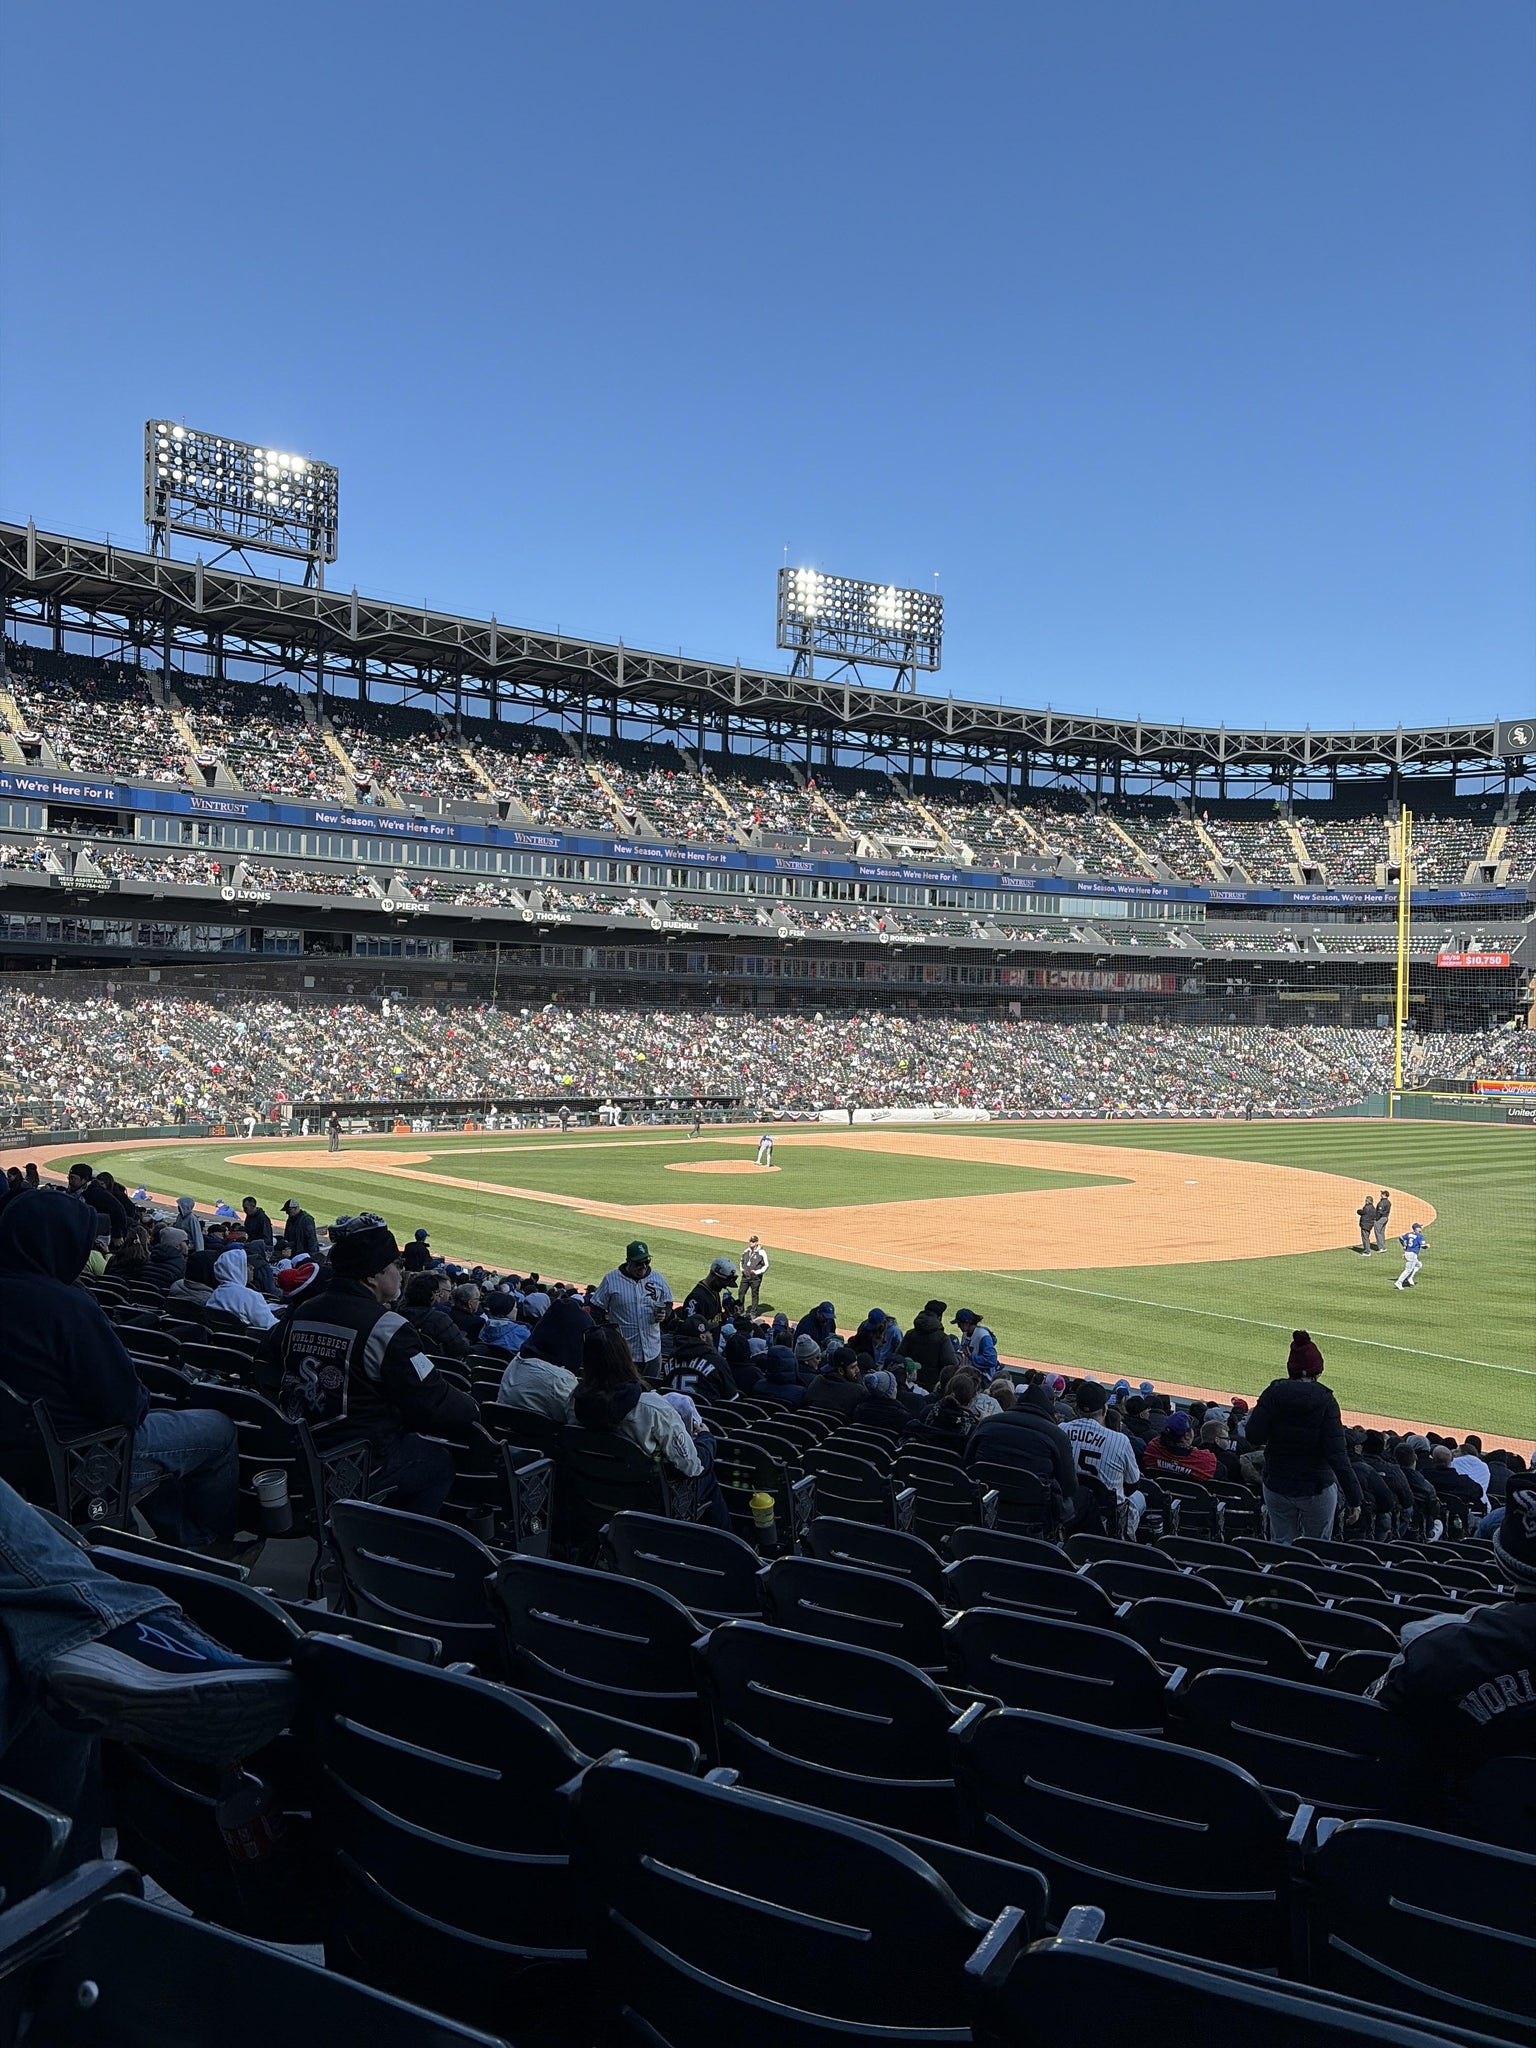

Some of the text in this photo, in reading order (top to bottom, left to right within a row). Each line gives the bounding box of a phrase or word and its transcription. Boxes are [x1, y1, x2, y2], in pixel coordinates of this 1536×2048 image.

[16, 778, 49, 792] We're
[53, 783, 80, 796] Here
[84, 787, 102, 798] For
[105, 790, 114, 799] It
[190, 797, 248, 813] WINTRUST
[316, 812, 455, 835] New Season, We're Here For It
[514, 832, 560, 846] WINTRUST
[614, 844, 727, 862] New Season, We're Here For It
[775, 858, 814, 870] WINTRUST
[860, 867, 875, 875] New
[876, 868, 902, 878] Season,
[904, 870, 922, 879] We're
[923, 872, 939, 880] Here
[940, 873, 951, 881] For
[1093, 884, 1116, 893] Season,
[238, 890, 271, 900] LYONS
[1209, 890, 1247, 899] WINTRUST
[1312, 894, 1340, 902] Season,
[396, 902, 430, 911] PIERCE
[536, 912, 571, 921] THOMAS
[663, 921, 699, 930] BUEHRLE
[1466, 956, 1502, 965] $10,750
[1502, 1084, 1536, 1094] Surfside
[1508, 1108, 1536, 1117] United
[1408, 1238, 1414, 1247] 5
[292, 1332, 348, 1350] WORLD SERIES
[292, 1343, 337, 1358] CHAMPIONS
[1078, 1449, 1102, 1476] 5
[92, 1506, 102, 1514] 24
